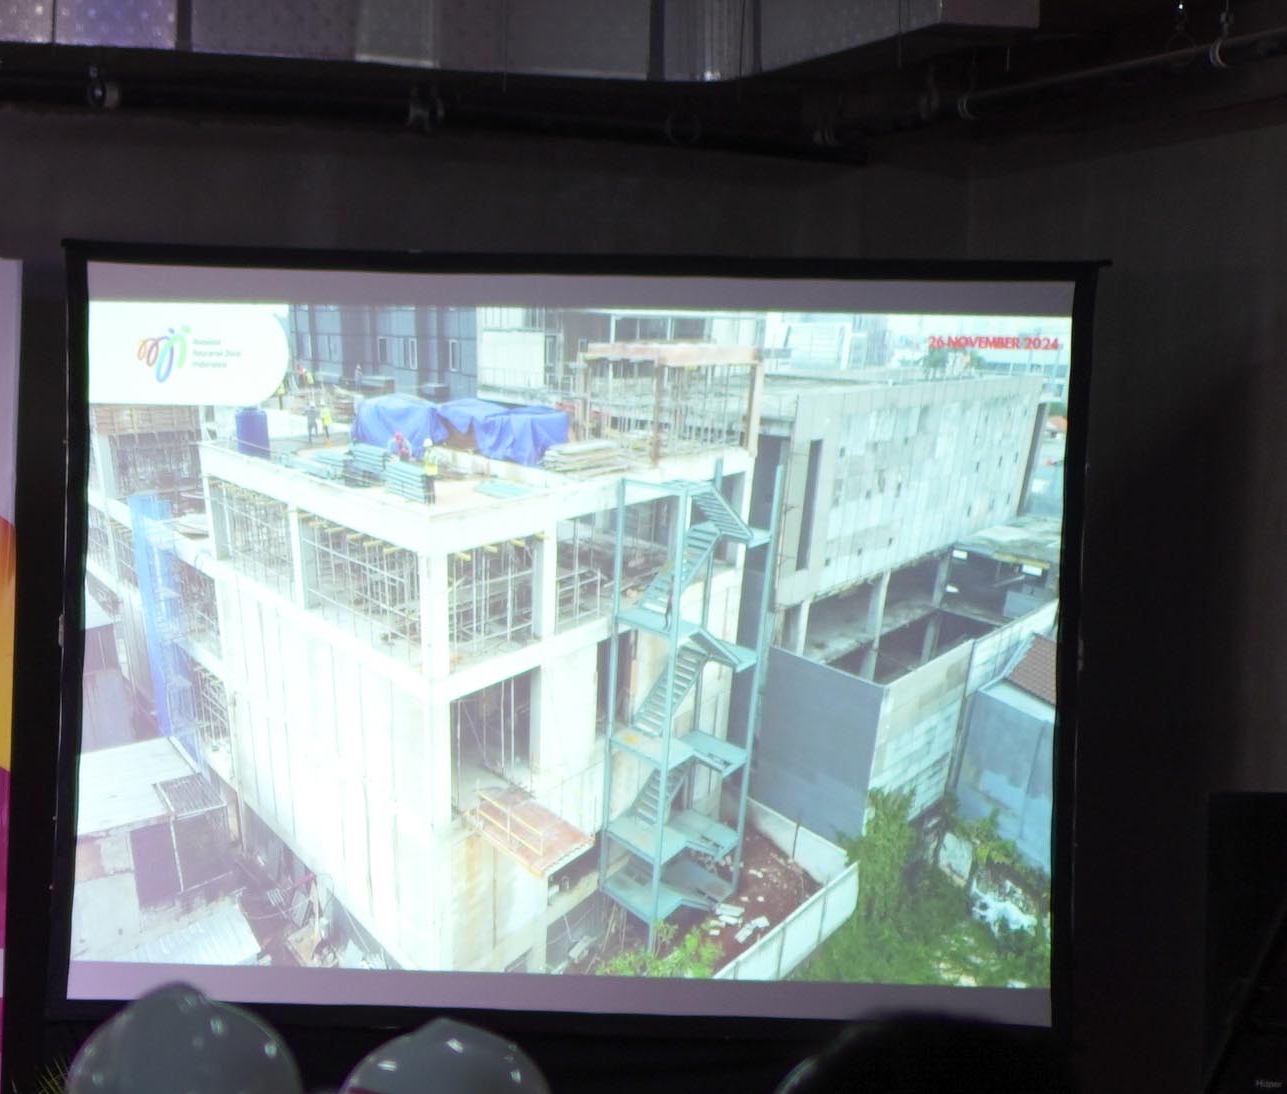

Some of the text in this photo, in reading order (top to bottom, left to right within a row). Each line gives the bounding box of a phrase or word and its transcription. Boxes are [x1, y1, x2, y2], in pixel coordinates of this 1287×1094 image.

[929, 336, 1059, 350] 26 NOVEMBER 2024
